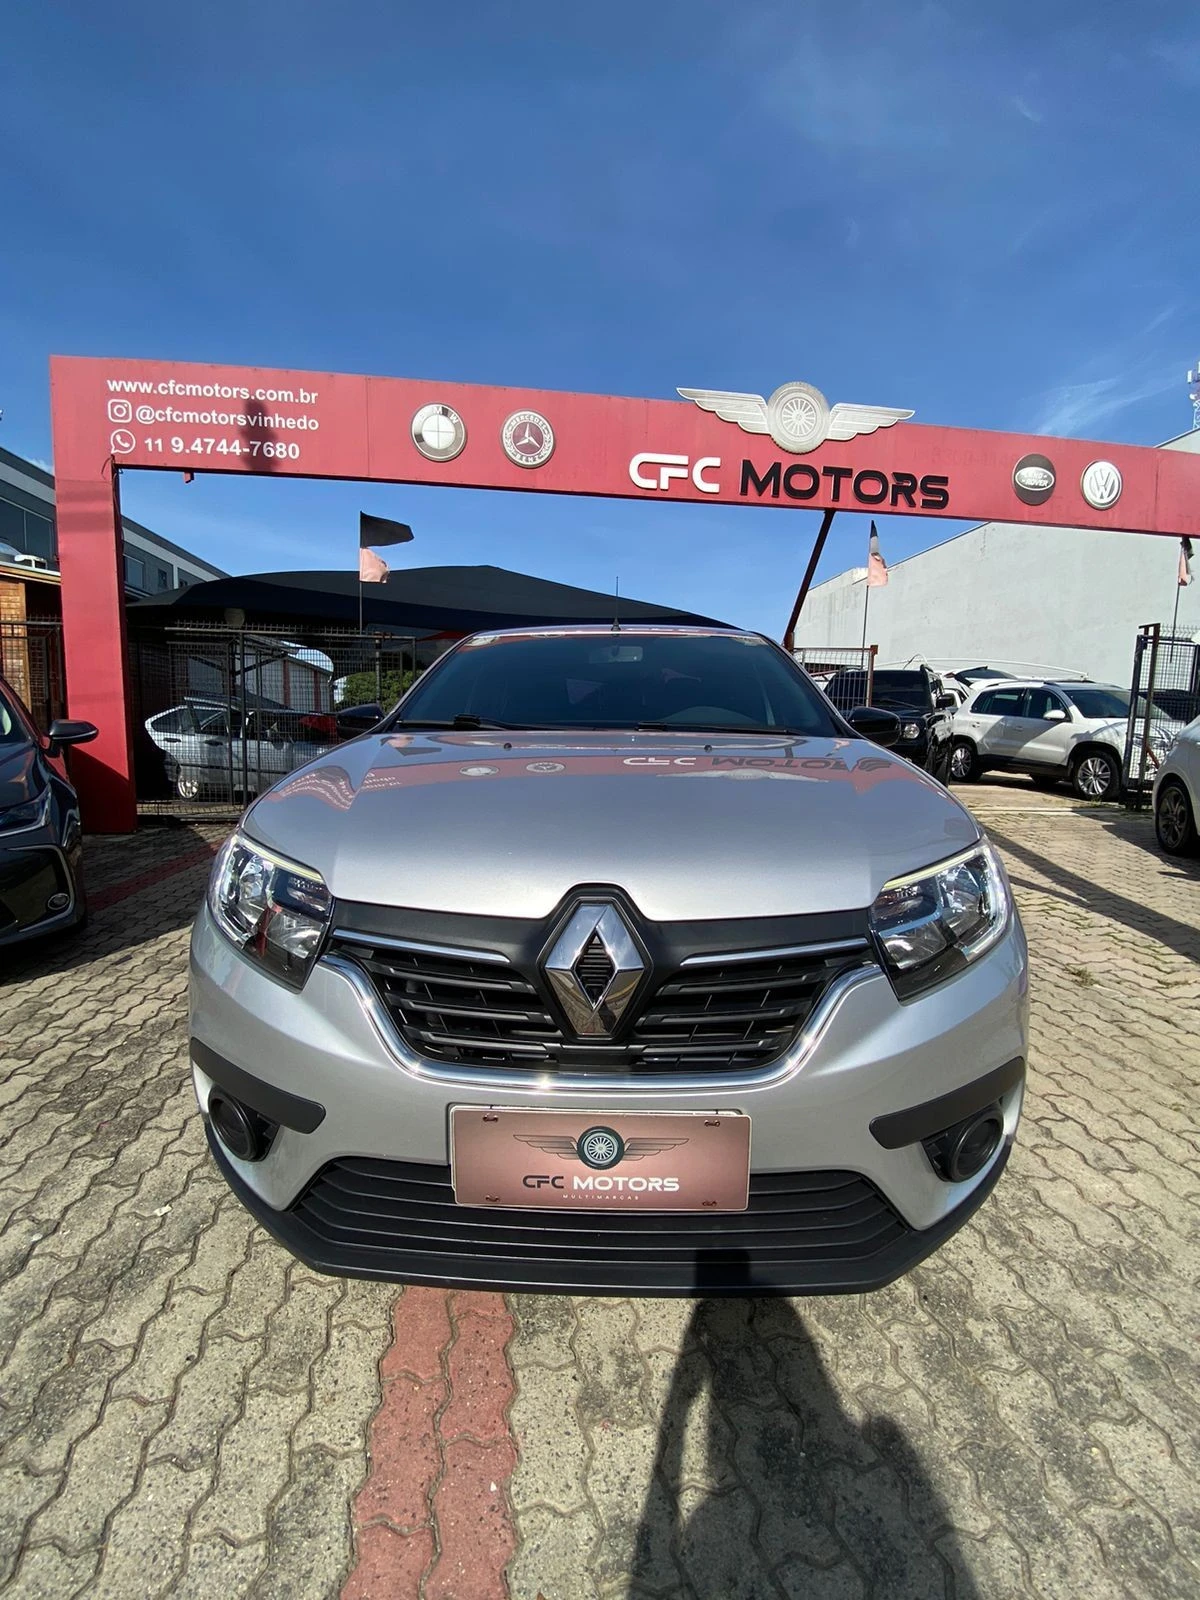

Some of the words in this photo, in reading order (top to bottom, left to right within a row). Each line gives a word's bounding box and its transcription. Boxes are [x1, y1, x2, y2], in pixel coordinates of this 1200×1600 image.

[106, 379, 319, 404] www.cfcmotors.com.br
[136, 405, 319, 430] @cfcmotorsvinhedo
[144, 438, 163, 452] 11
[171, 437, 300, 459] 9.4744-7680
[628, 452, 721, 493] CFC
[739, 459, 950, 510] MOTORS
[522, 1175, 565, 1189] CFC
[573, 1175, 680, 1192] MOTORS
